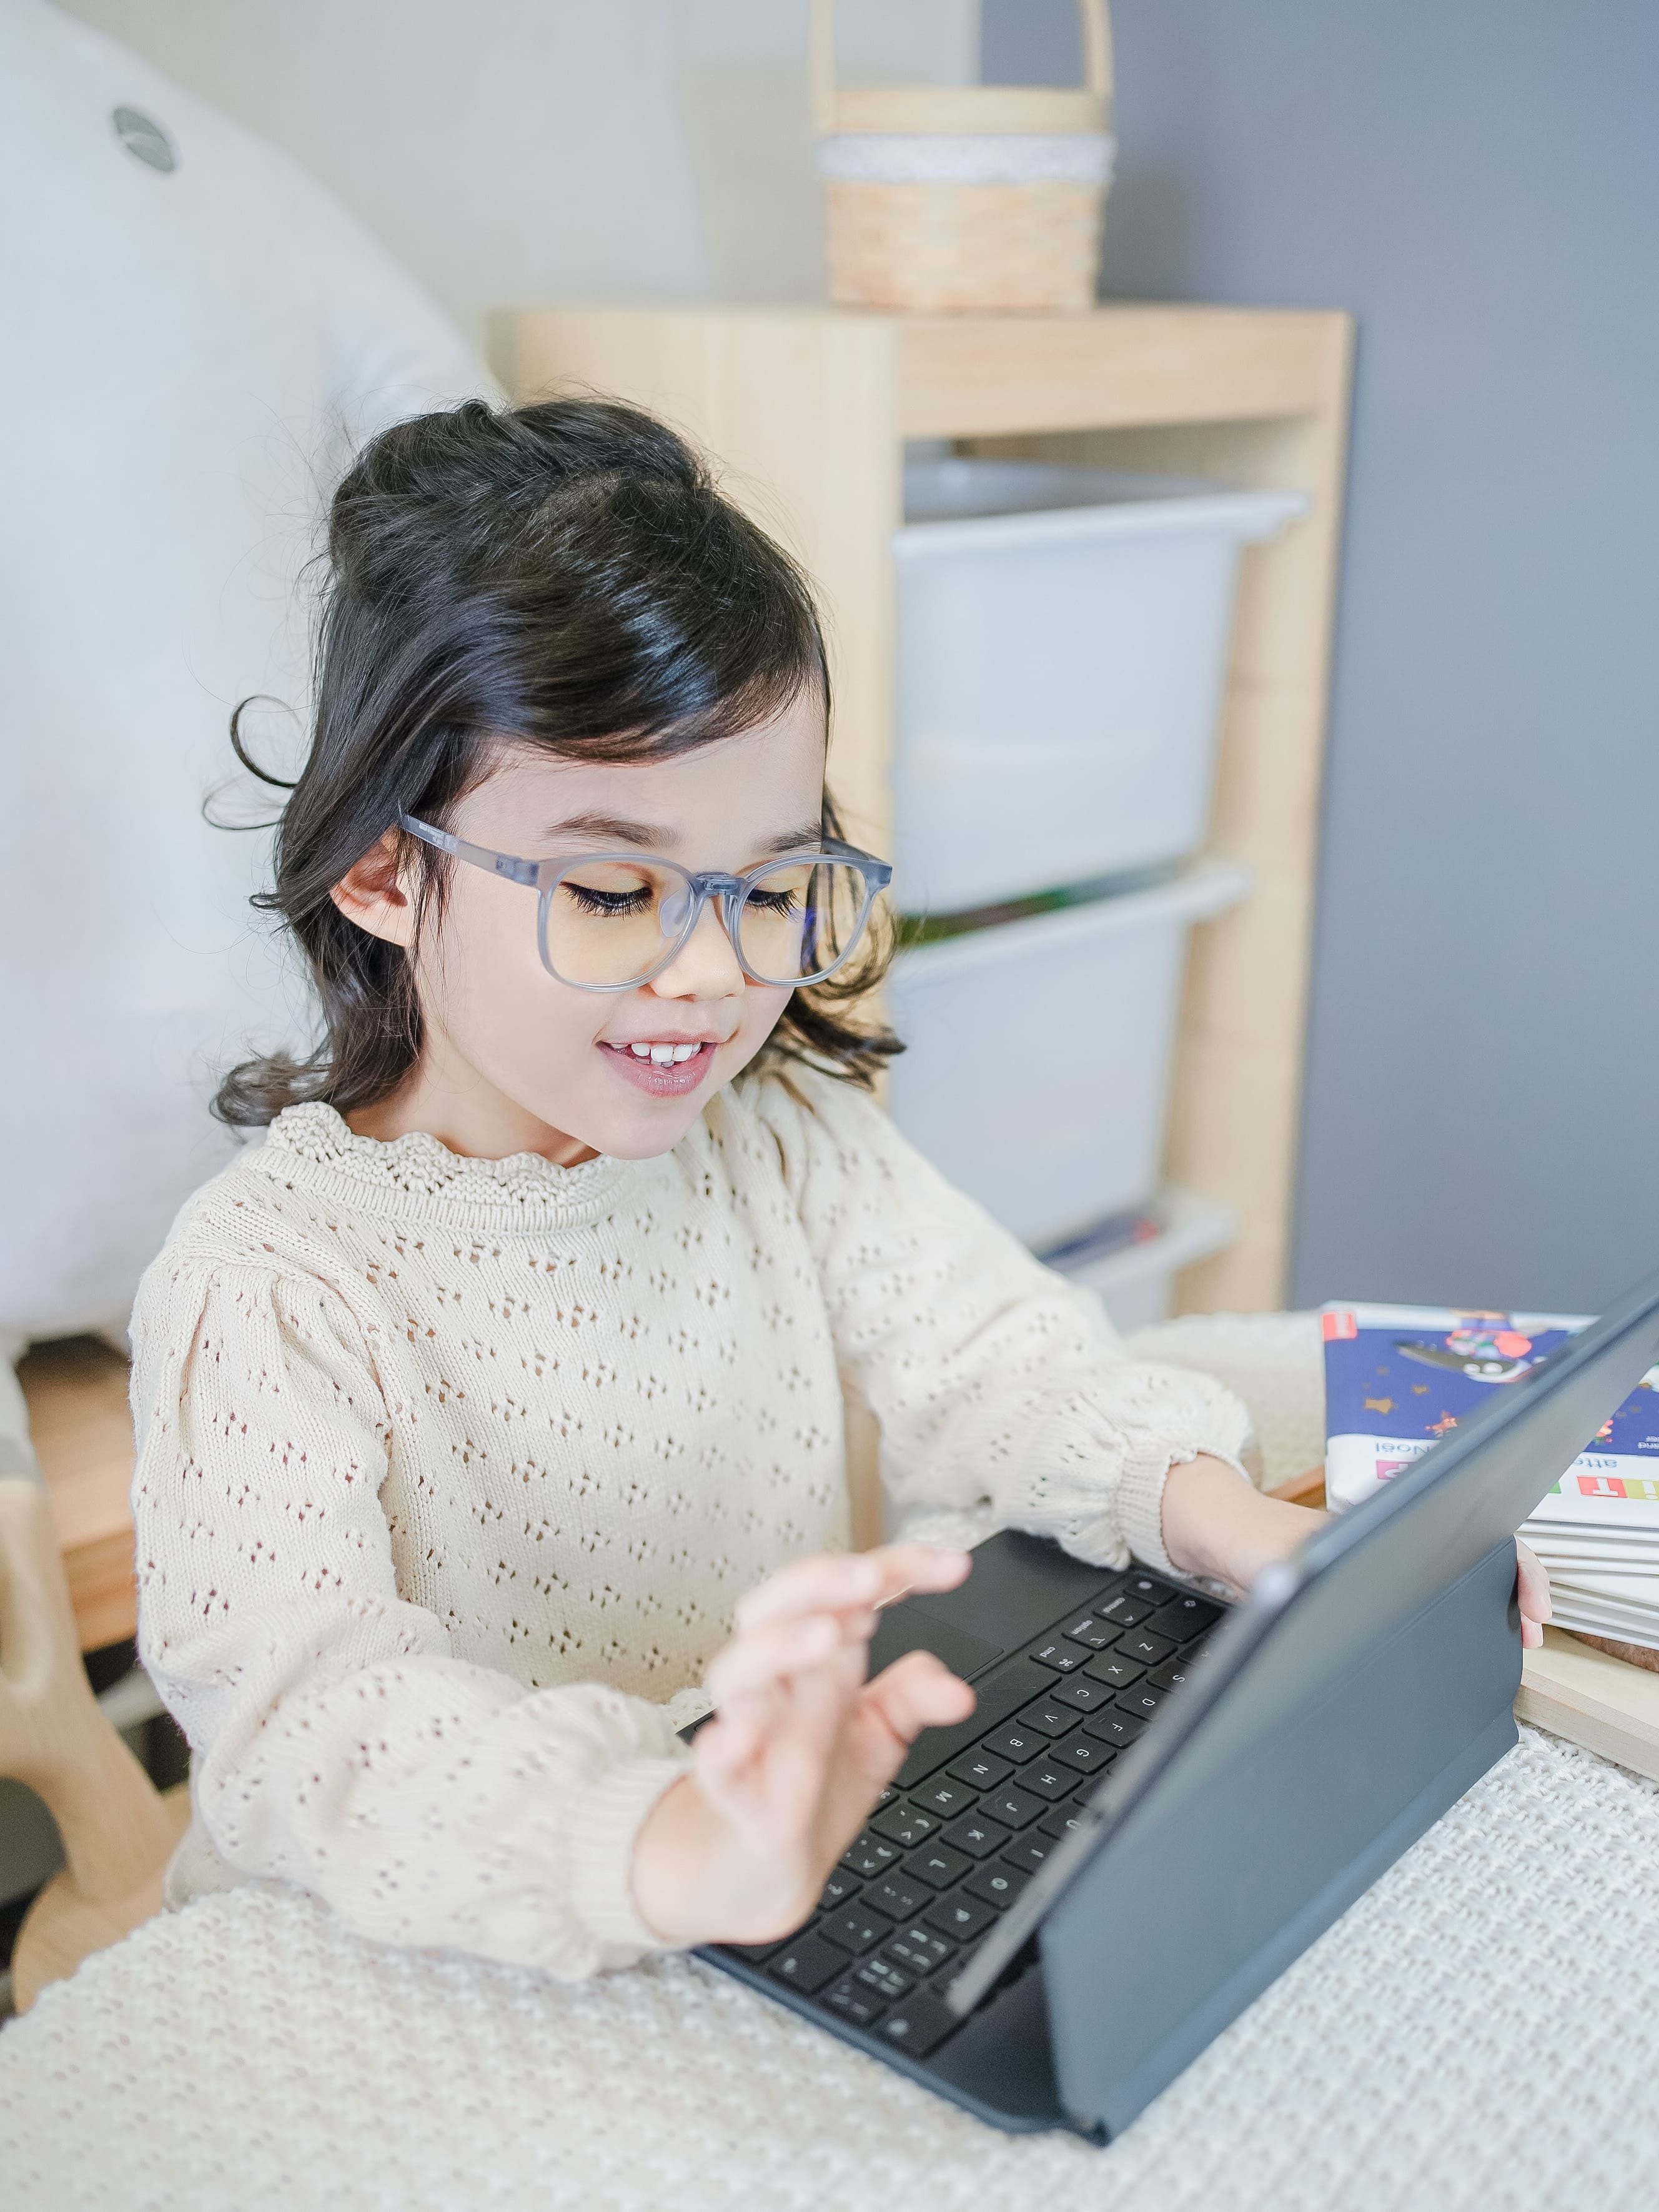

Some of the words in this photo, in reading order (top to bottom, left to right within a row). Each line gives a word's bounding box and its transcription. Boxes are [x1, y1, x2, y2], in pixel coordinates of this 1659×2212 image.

[1376, 1442, 1429, 1454] Noël
[1071, 1620, 1093, 1635] option
[1138, 1642, 1154, 1652] Z
[1039, 1647, 1056, 1658] cmd
[1107, 1665, 1123, 1674] X
[1172, 1674, 1186, 1683] S
[1076, 1689, 1090, 1697] C
[1142, 1698, 1156, 1706] D
[1044, 1715, 1058, 1723] V
[1112, 1723, 1124, 1732] F
[1009, 1738, 1024, 1747] B
[1076, 1748, 1089, 1757] G
[973, 1763, 989, 1774] N
[1041, 1774, 1057, 1785] H
[935, 1790, 953, 1803] M
[1006, 1802, 1018, 1812] J
[968, 1829, 984, 1841] K
